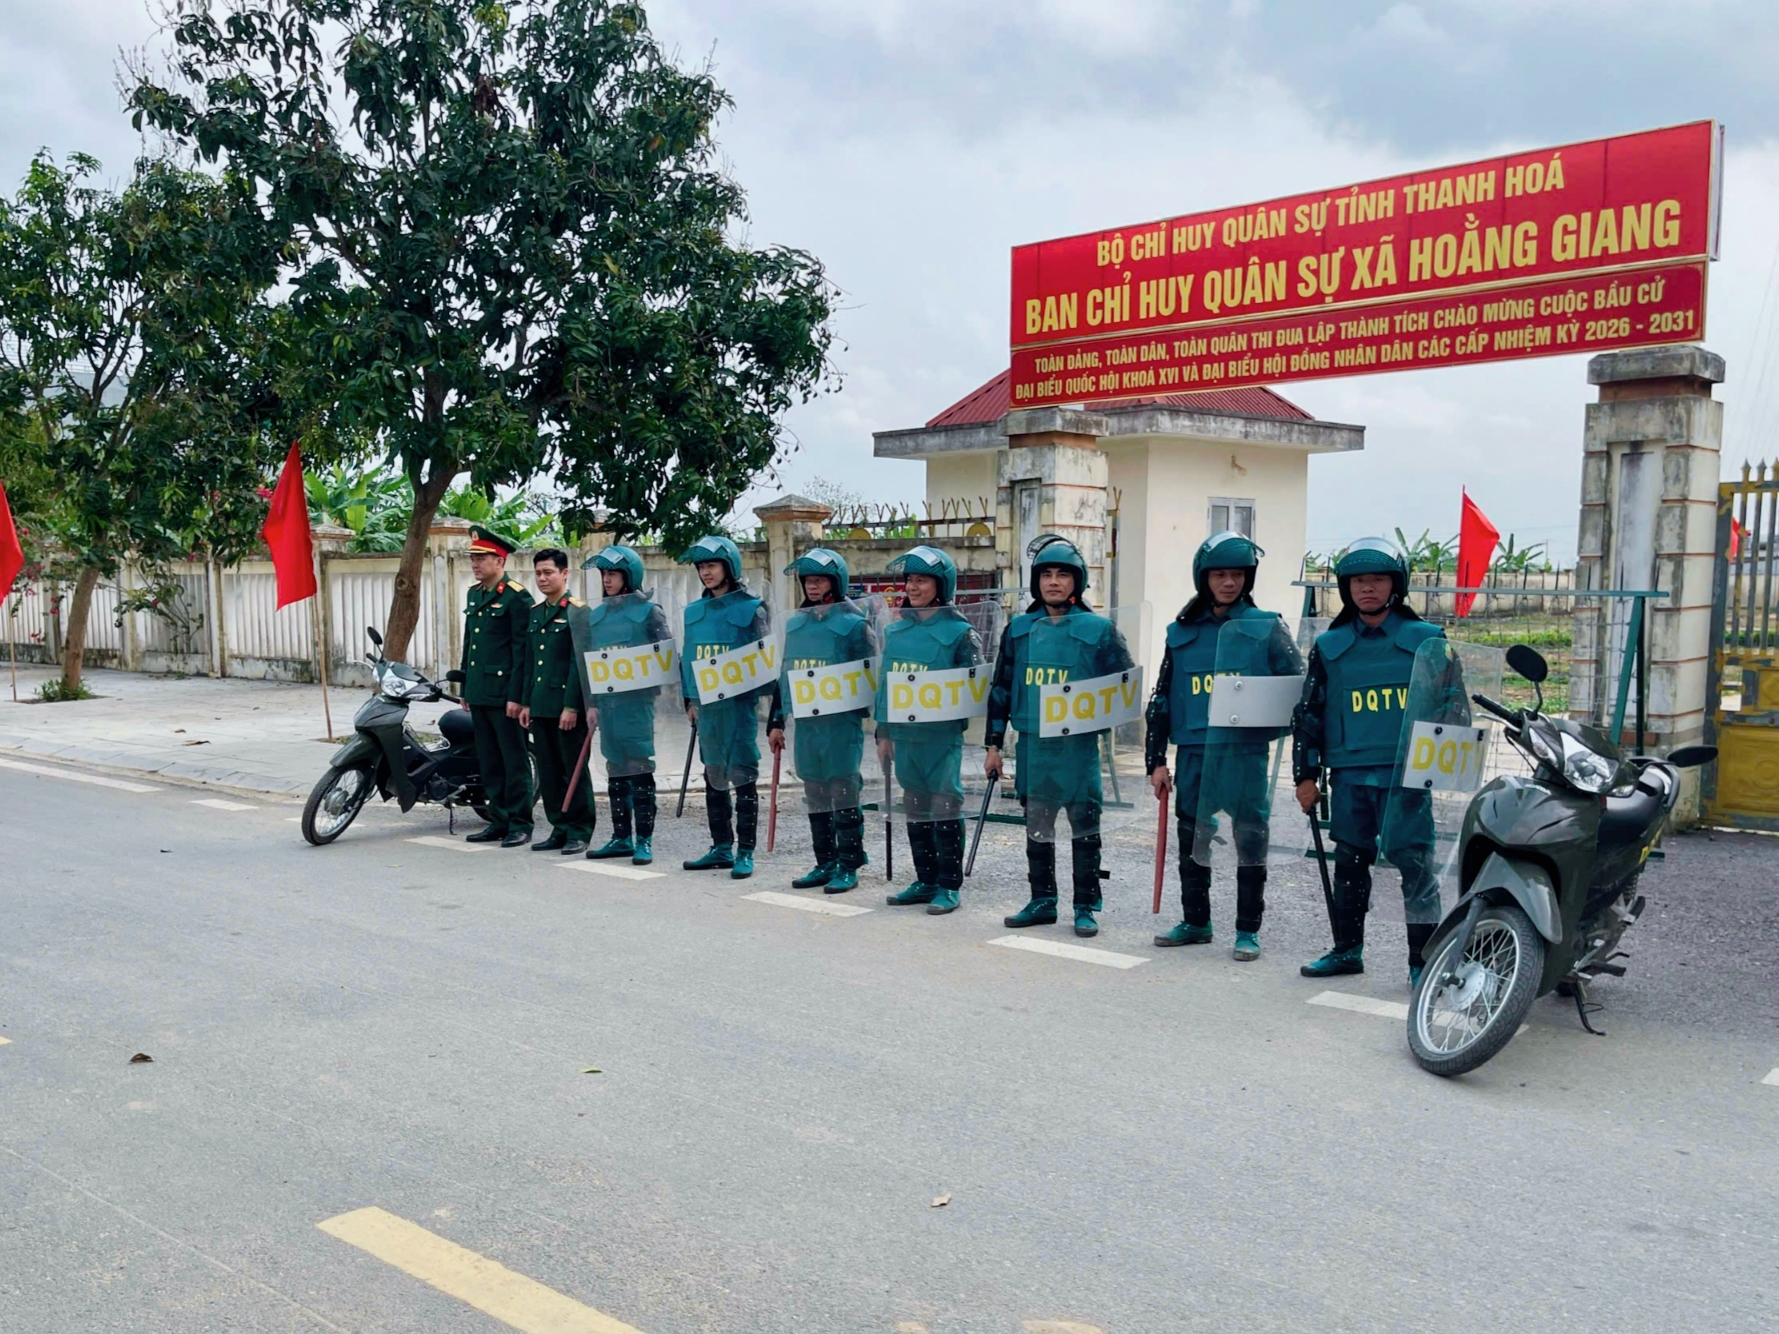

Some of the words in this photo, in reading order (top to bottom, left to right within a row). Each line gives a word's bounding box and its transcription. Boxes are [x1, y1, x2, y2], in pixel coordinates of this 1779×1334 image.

[1097, 233, 1124, 269] BỘ
[1130, 222, 1166, 262] CHỈ
[1173, 222, 1216, 255] HUY
[1222, 207, 1287, 248] QUÂN
[1294, 197, 1331, 236] SỰ
[1335, 186, 1395, 227] TỈNH
[1403, 170, 1495, 214] THANH
[1505, 152, 1565, 198] HOÁ
[1026, 293, 1078, 334] BAN
[1086, 271, 1130, 327] CHỈ
[1139, 274, 1194, 319] HUY
[1203, 256, 1287, 313] QUÂN
[1297, 247, 1345, 303] SỰ
[1351, 235, 1397, 290] XÃ
[1408, 213, 1538, 282] HOẰNG
[1551, 199, 1681, 262] GIANG
[1035, 353, 1064, 374] TOÀN
[1067, 348, 1102, 370] ĐẢNG,
[1106, 345, 1137, 365] TOÀN
[1140, 341, 1170, 362] DÂN,
[1173, 336, 1207, 359] TOÀN
[1210, 332, 1247, 355] QUÂN
[1251, 331, 1272, 349] THI
[1276, 327, 1304, 346] ĐUA
[1308, 321, 1335, 347] LẬP
[1339, 316, 1389, 340] THÀNH
[1394, 311, 1429, 333] TÍCH
[1433, 303, 1478, 329] CHÀO
[1483, 298, 1535, 323] MỪNG
[1540, 289, 1588, 317] CUỘC
[1593, 280, 1632, 310] BẦU
[1637, 275, 1665, 304] CỬ
[1015, 383, 1034, 401] ĐẠI
[1037, 374, 1062, 397] BIỂU
[1065, 371, 1096, 395] QUỐC
[1099, 371, 1119, 393] HỘI
[1122, 367, 1155, 389] KHOÁ
[1158, 367, 1179, 385] XVI
[1182, 362, 1199, 382] VÀ
[1202, 362, 1225, 383] ĐẠI
[1228, 352, 1259, 378] BIỂU
[1263, 353, 1287, 377] HỘI
[1290, 347, 1330, 372] ĐỒNG
[1334, 344, 1377, 367] NHÂN
[1381, 340, 1413, 362] DÂN
[1417, 335, 1450, 359] CÁC
[1455, 328, 1489, 355] CẤP
[1494, 324, 1551, 352] NHIỆM
[1557, 319, 1580, 344] KỲ
[1584, 317, 1630, 341] 2026
[1648, 310, 1694, 335] 2031
[590, 649, 673, 683] DQTV
[698, 644, 775, 692] DQTV
[1025, 667, 1068, 686] DQTV
[892, 676, 989, 710] DQTV
[1045, 680, 1138, 724] DQTV
[1352, 688, 1407, 713] DQTV
